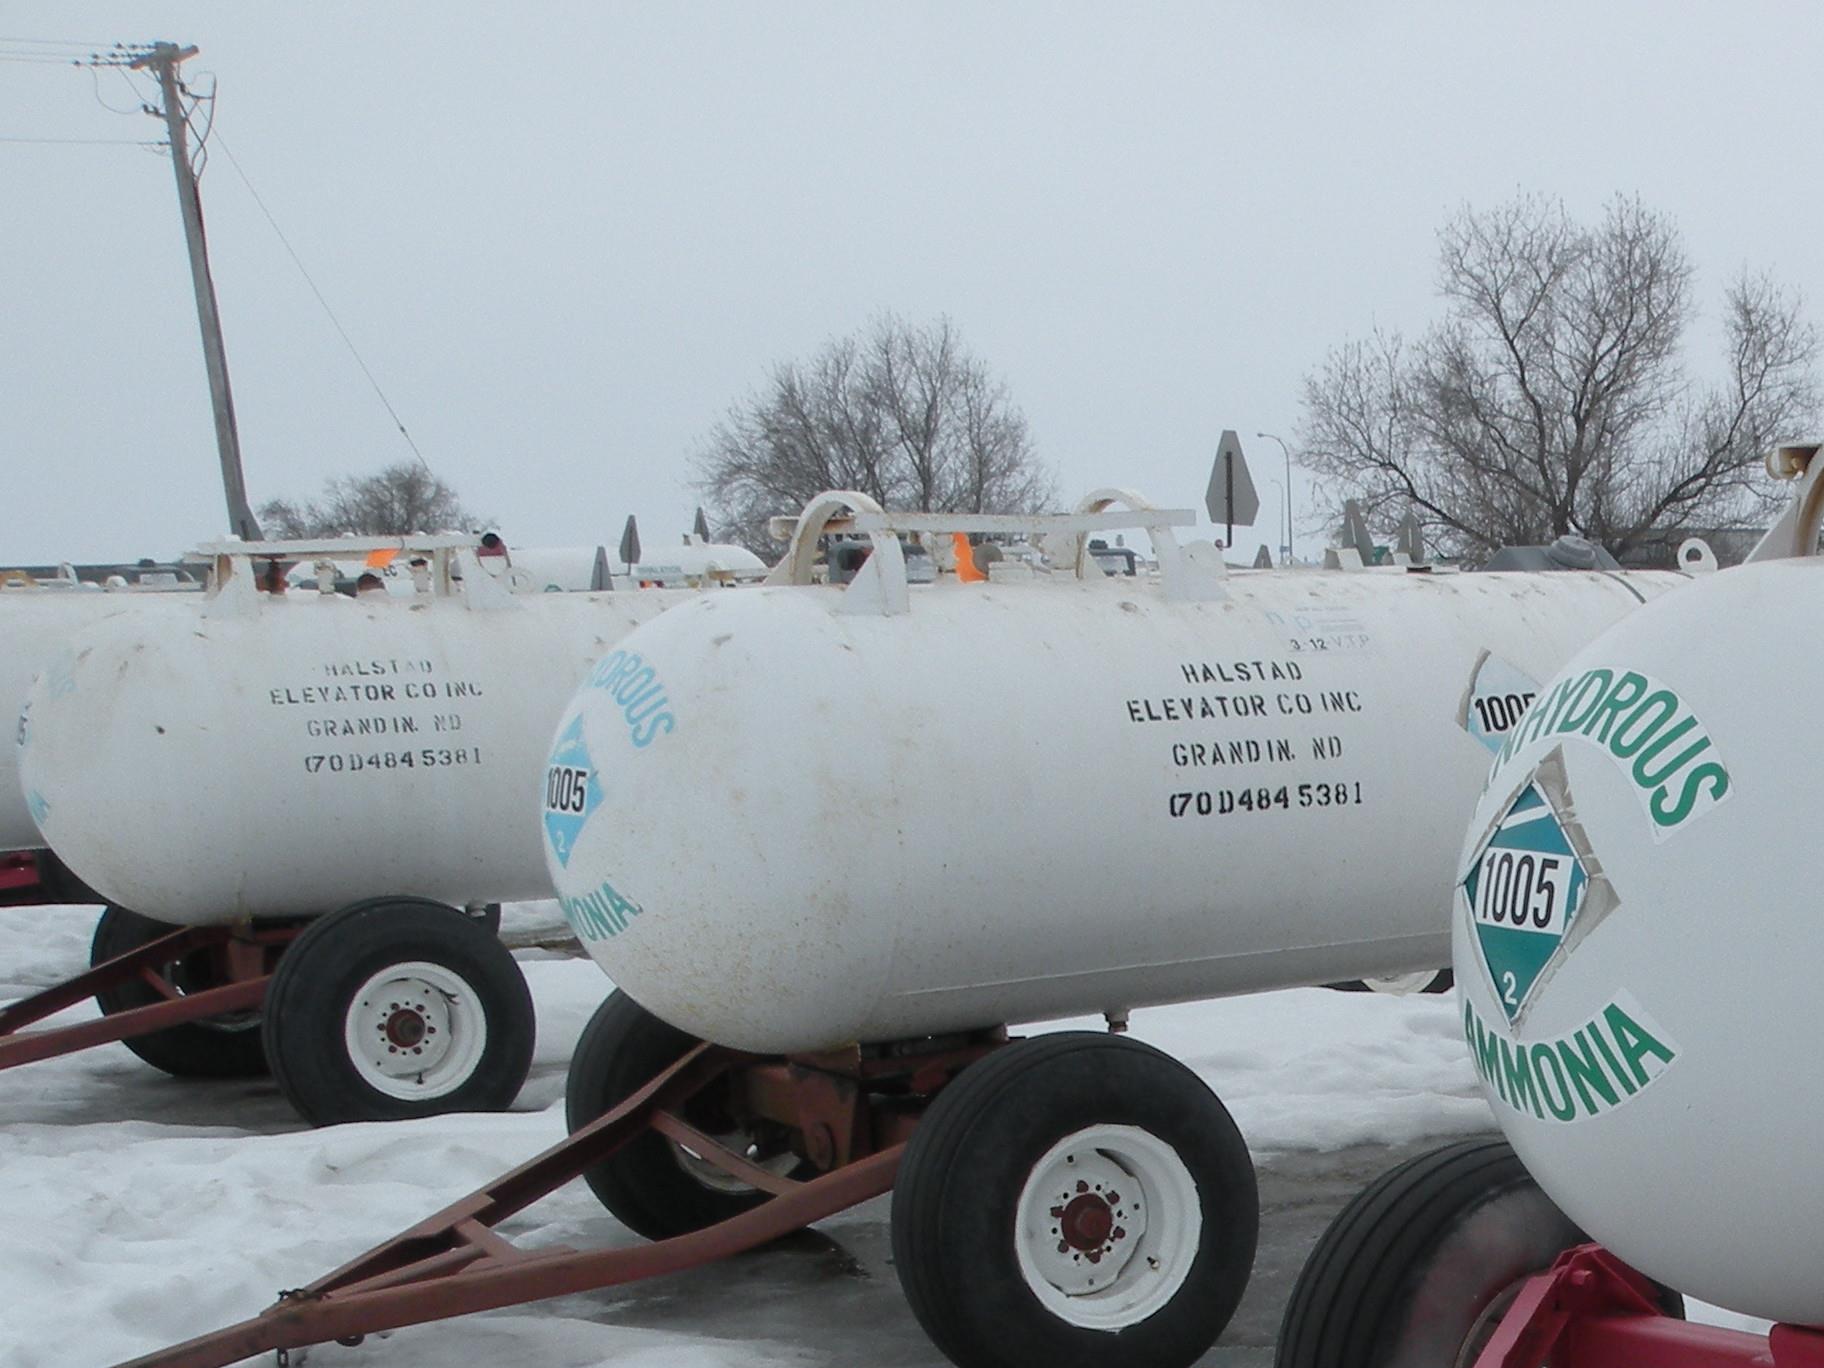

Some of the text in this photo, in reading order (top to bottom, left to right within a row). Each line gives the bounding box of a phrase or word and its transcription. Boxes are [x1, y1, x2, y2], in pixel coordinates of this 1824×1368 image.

[325, 659, 433, 677] HALSTAD
[1181, 661, 1303, 683] HALSTAD
[270, 681, 483, 705] ELEVATOR CO INC
[1127, 691, 1362, 722] ELEVATOR CO INC
[434, 713, 462, 732] ND
[1312, 736, 1342, 759] ND
[546, 766, 587, 813] 1005
[1482, 852, 1559, 928] 1005
[565, 881, 641, 942] ONIA
[1503, 971, 1518, 1005] 2
[1464, 997, 1675, 1122] AMMONIA
